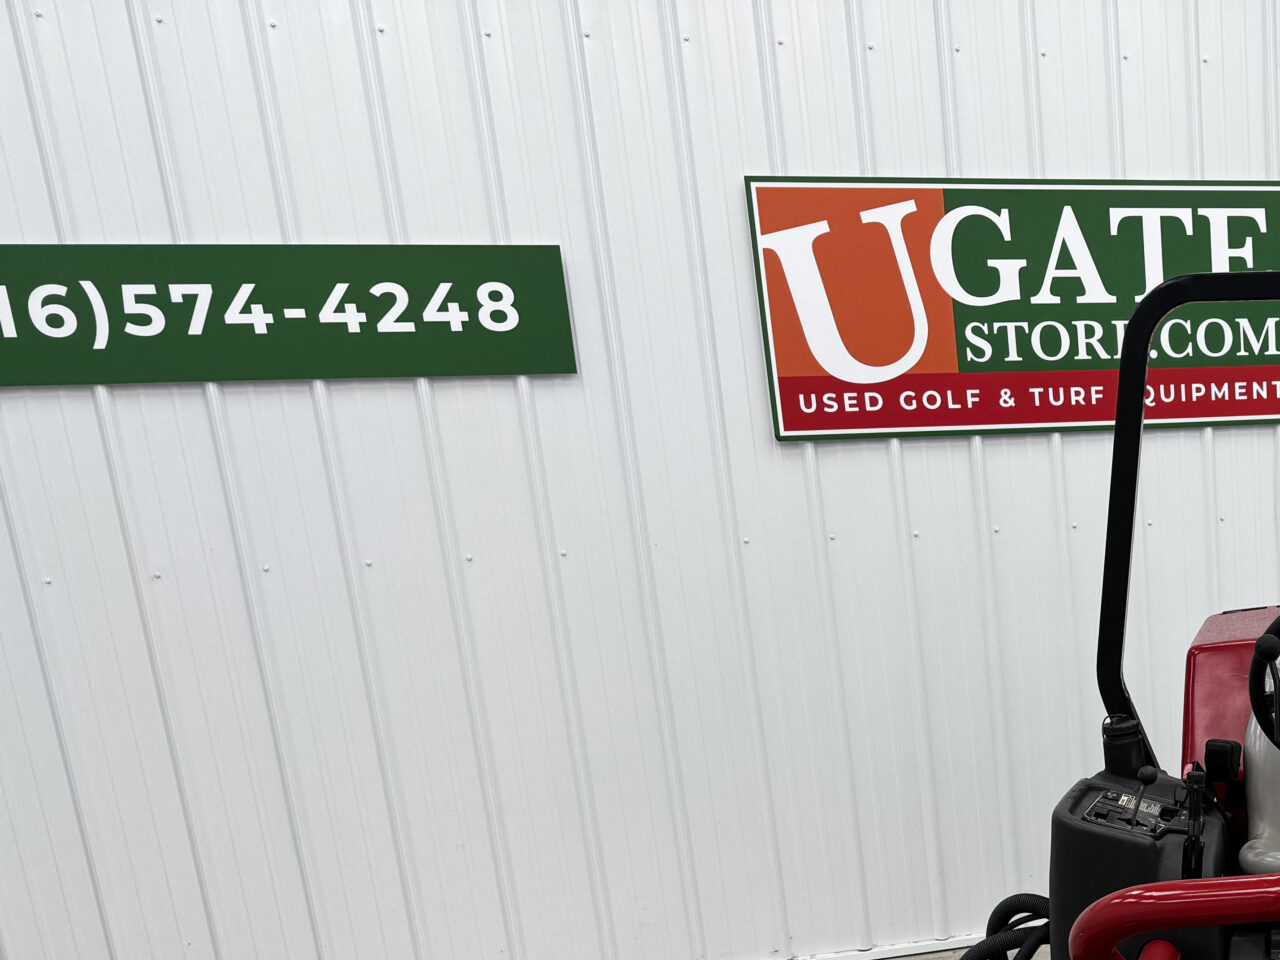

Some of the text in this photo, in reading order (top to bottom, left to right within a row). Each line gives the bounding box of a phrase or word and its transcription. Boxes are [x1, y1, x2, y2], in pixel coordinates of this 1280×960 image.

[761, 199, 1268, 385] UGATE
[798, 392, 884, 414] USED
[899, 389, 980, 411] GOLF
[999, 388, 1016, 408] &
[1028, 386, 1104, 407] TURF
